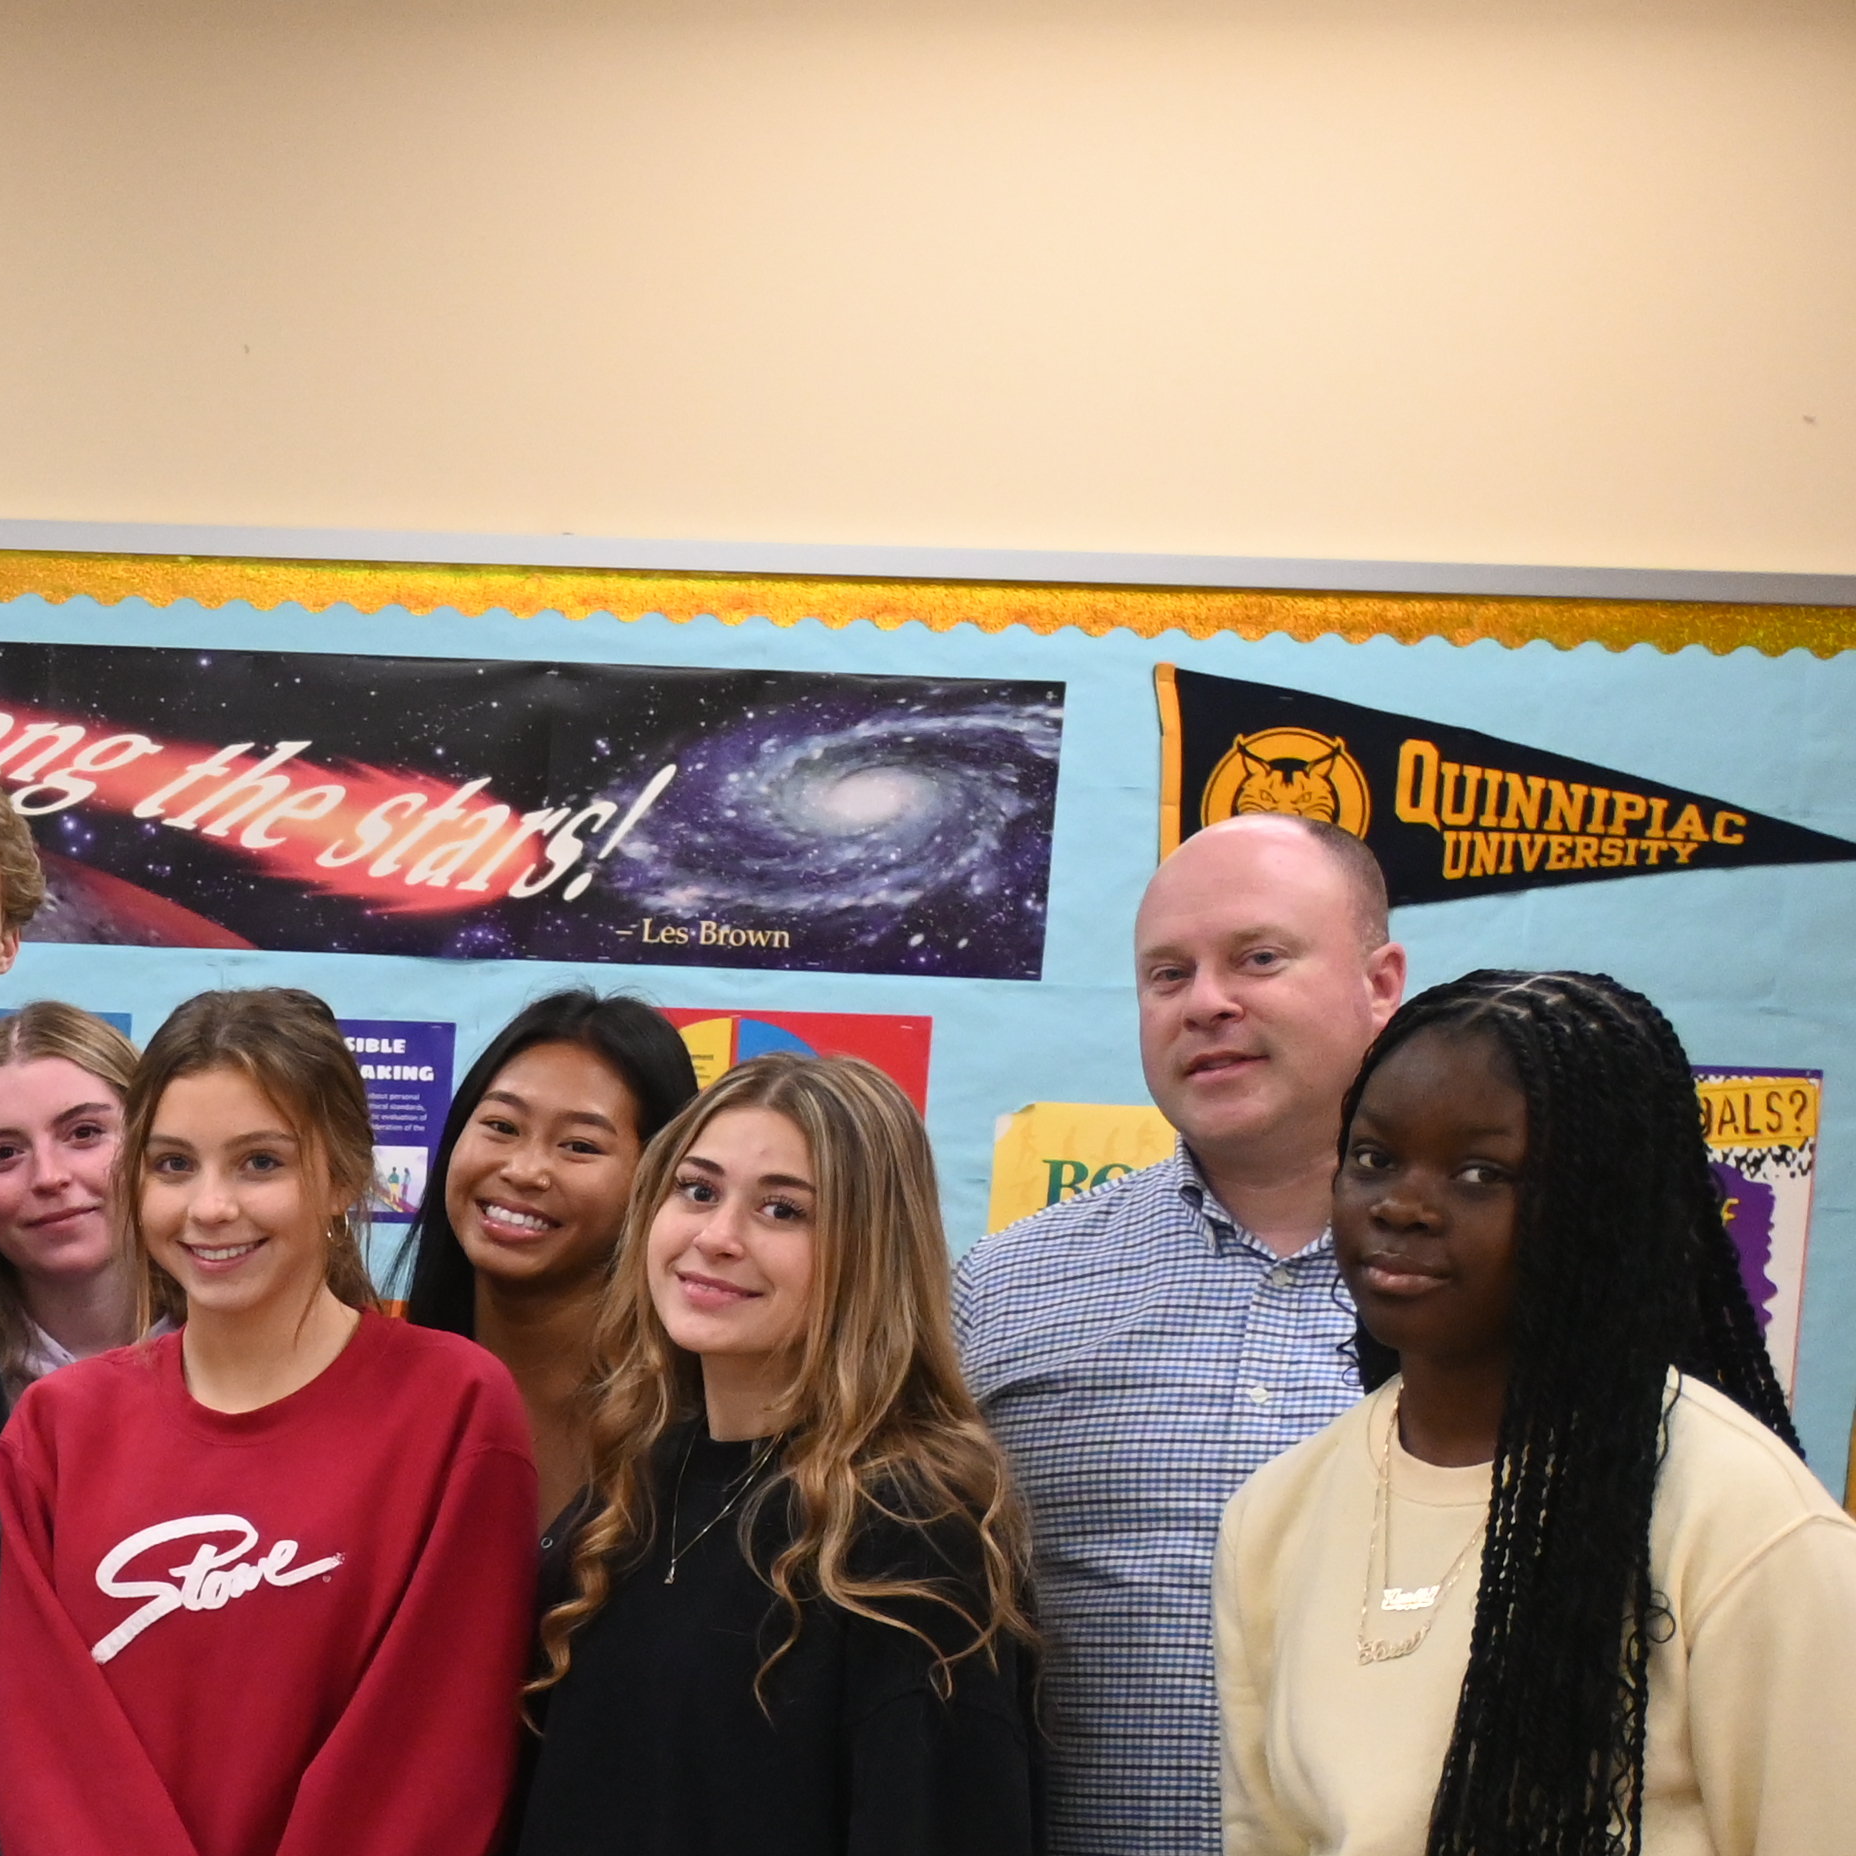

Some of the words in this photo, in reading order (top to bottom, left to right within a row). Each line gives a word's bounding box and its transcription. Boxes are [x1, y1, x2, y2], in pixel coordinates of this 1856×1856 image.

[1395, 737, 1748, 846] QUINNIPIAC
[131, 740, 313, 849] the
[317, 762, 677, 903] stars!
[1441, 829, 1700, 881] UNIVERSITY
[641, 917, 689, 944] Les
[698, 919, 791, 949] Brown
[360, 1064, 435, 1082] AKING
